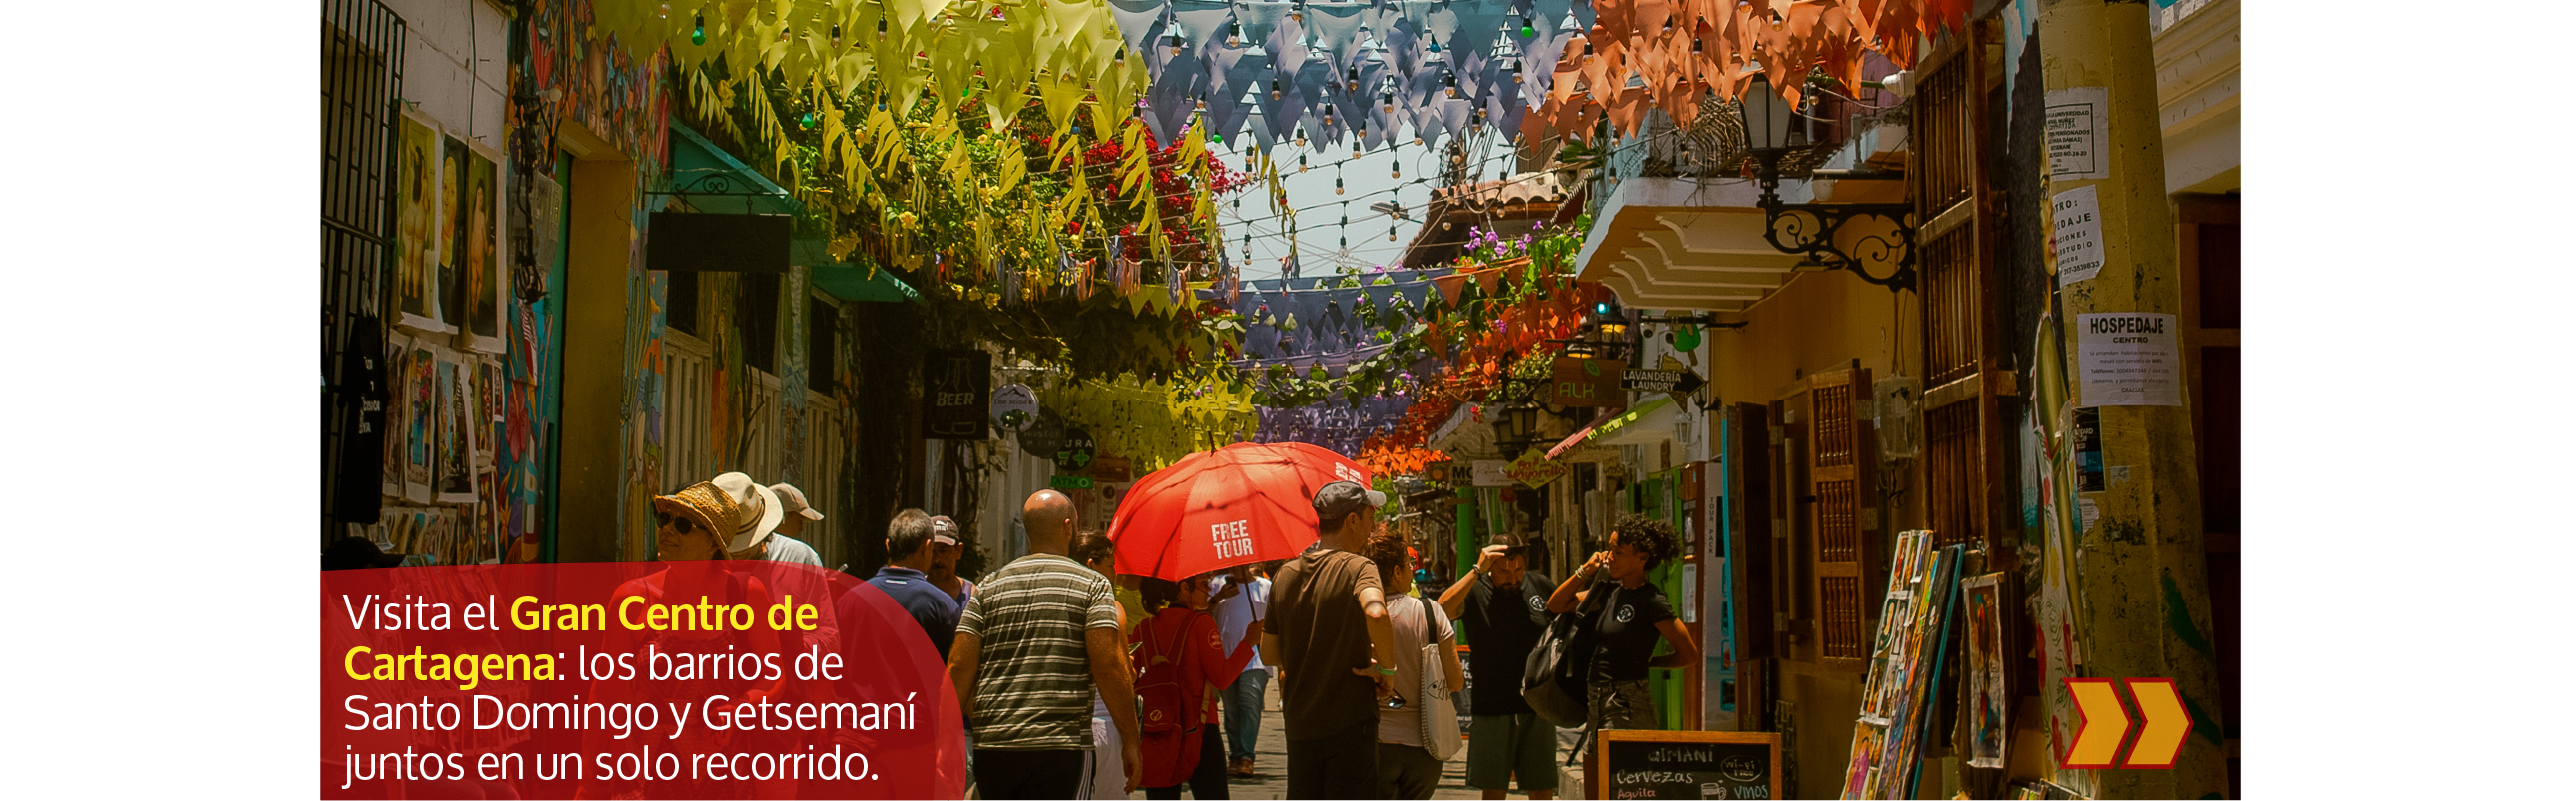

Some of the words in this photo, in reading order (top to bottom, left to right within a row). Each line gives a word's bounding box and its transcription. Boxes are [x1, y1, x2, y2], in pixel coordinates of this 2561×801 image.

[2055, 200, 2078, 213] TRO:
[2058, 241, 2093, 257] ESTUDIO
[2090, 317, 2164, 334] HOSPEDAJE
[2112, 336, 2149, 344] CENTRO
[1622, 370, 1682, 383] LAVANDERÍA
[1631, 381, 1675, 391] LAUNDRY
[936, 391, 975, 407] BEER
[1064, 439, 1093, 448] URA
[1055, 477, 1078, 486] ATM
[1211, 519, 1249, 541] FREE
[1213, 538, 1254, 560] TOUR
[1616, 769, 1694, 785] Cervezas
[1617, 787, 1656, 800] Aguila
